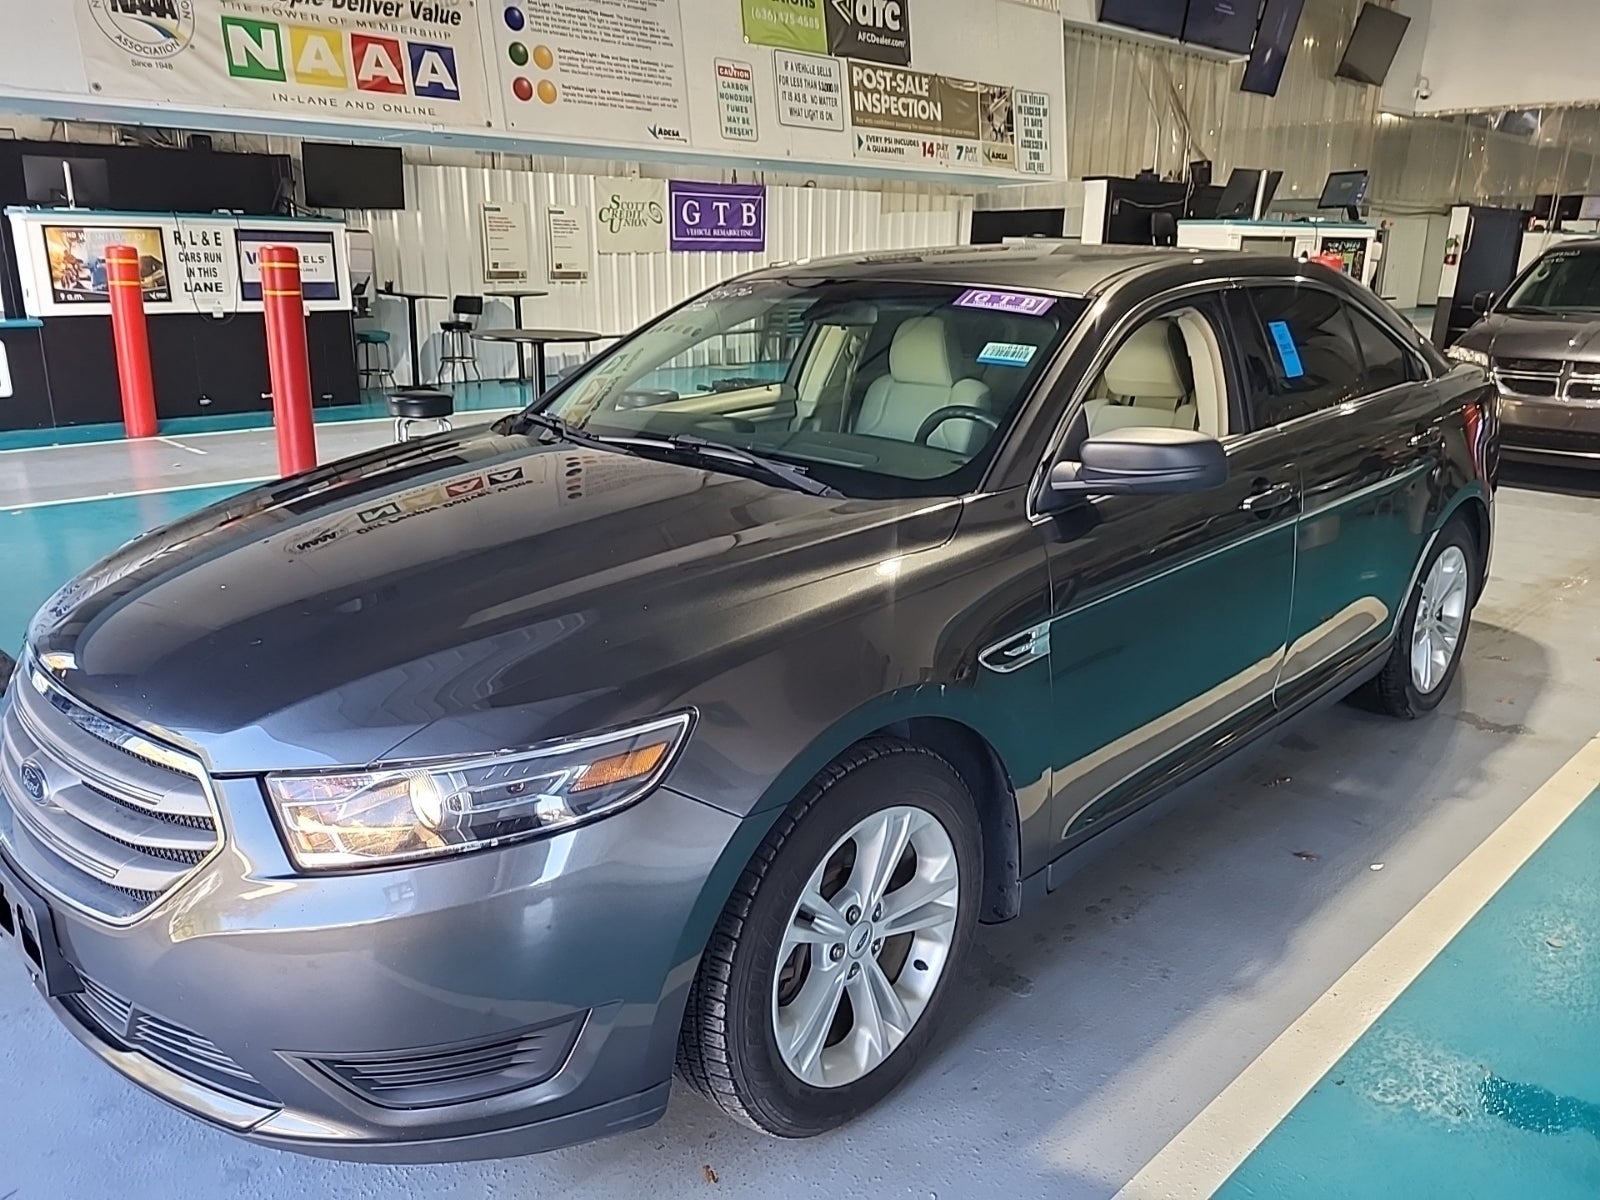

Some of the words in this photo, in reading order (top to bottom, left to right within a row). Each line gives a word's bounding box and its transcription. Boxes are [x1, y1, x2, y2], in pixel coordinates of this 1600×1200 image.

[410, 0, 461, 26] Value
[220, 1, 252, 12] THE
[260, 6, 321, 23] POWER
[328, 16, 348, 26] OF
[356, 20, 451, 40] MEMBERSHIP
[114, 35, 181, 56] ASSOCIATION
[130, 59, 153, 69] Since
[795, 63, 816, 76] VEHICLE
[817, 65, 832, 78] SELLS
[719, 67, 750, 79] CAUTION
[721, 81, 749, 92] CARBON
[779, 74, 790, 87] FOR
[790, 76, 803, 89] LESS
[804, 78, 818, 90] THAN
[852, 66, 929, 97] POST-SALE
[272, 93, 338, 107] IN-LANE
[345, 100, 375, 111] AND
[382, 103, 437, 117] ONLINE
[719, 92, 753, 104] MONOXIDE
[810, 94, 818, 106] NO
[818, 95, 839, 108] MATTER
[726, 104, 749, 114] FUMES
[853, 90, 942, 121] INSPECTION
[726, 115, 740, 124] MAY
[741, 117, 750, 126] BE
[789, 107, 803, 118] WHAT
[804, 109, 819, 121] LIGHT
[724, 126, 753, 137] PRESENT
[865, 135, 883, 144] EVERY
[893, 137, 919, 148] INCLUDES
[872, 145, 905, 155] GUARANTEE
[921, 141, 935, 158] 14
[936, 142, 949, 152] DAY
[956, 145, 964, 160] 7
[965, 145, 977, 154] DAY
[610, 194, 647, 211] SCOTT
[598, 207, 642, 223] CREDIT
[610, 217, 649, 234] UNION
[686, 228, 711, 237] VEHICLE
[712, 229, 754, 237] REMARKETING
[173, 230, 187, 249] R,
[189, 230, 198, 246] L
[201, 231, 211, 247] &
[213, 231, 223, 247] E
[178, 251, 202, 263] CARS
[203, 251, 223, 263] RUN
[186, 267, 196, 278] IN
[197, 266, 218, 278] THIS
[183, 282, 224, 293] LANE
[66, 292, 85, 301] a.m.
[23, 768, 41, 797] Ford
